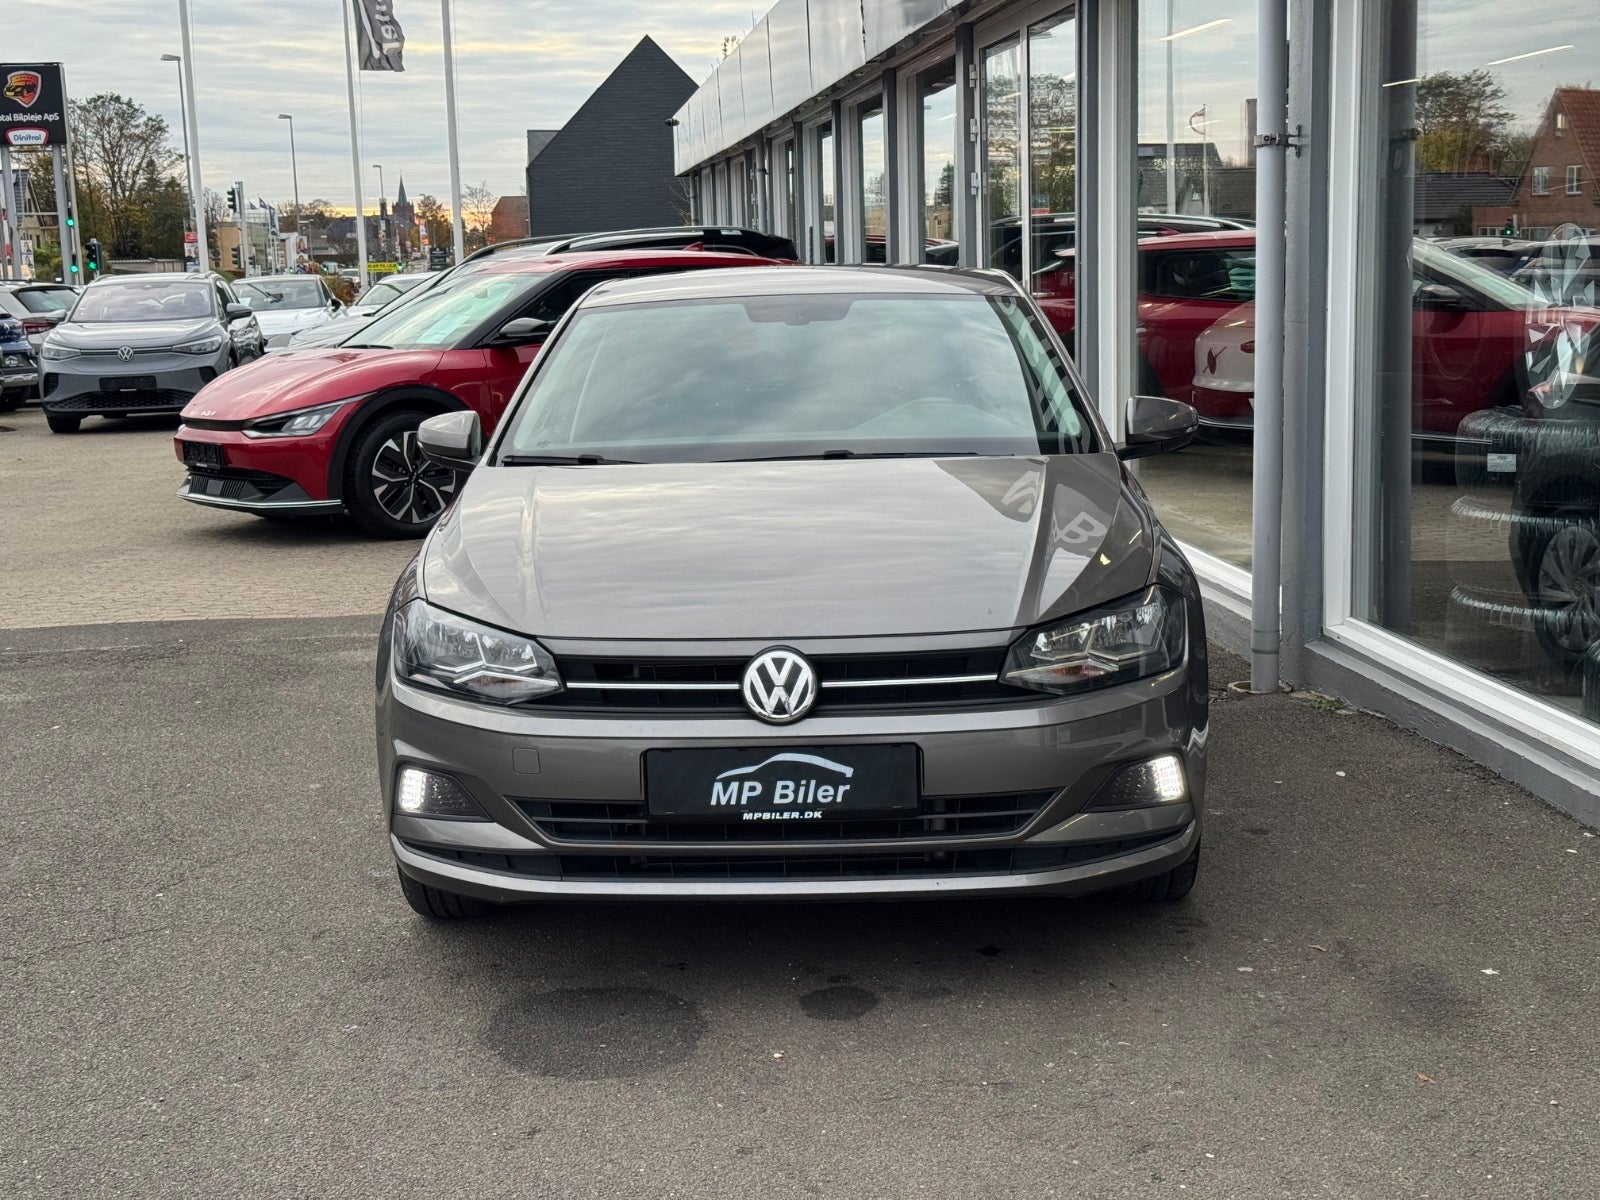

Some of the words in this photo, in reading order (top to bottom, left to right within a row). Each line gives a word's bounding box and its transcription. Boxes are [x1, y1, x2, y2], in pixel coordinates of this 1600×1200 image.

[13, 112, 43, 122] Bilpleje
[43, 112, 60, 122] ApS
[745, 650, 817, 719] VW
[710, 780, 763, 806] MP
[773, 779, 850, 805] Biler
[742, 810, 823, 821] MPBILER.DK
